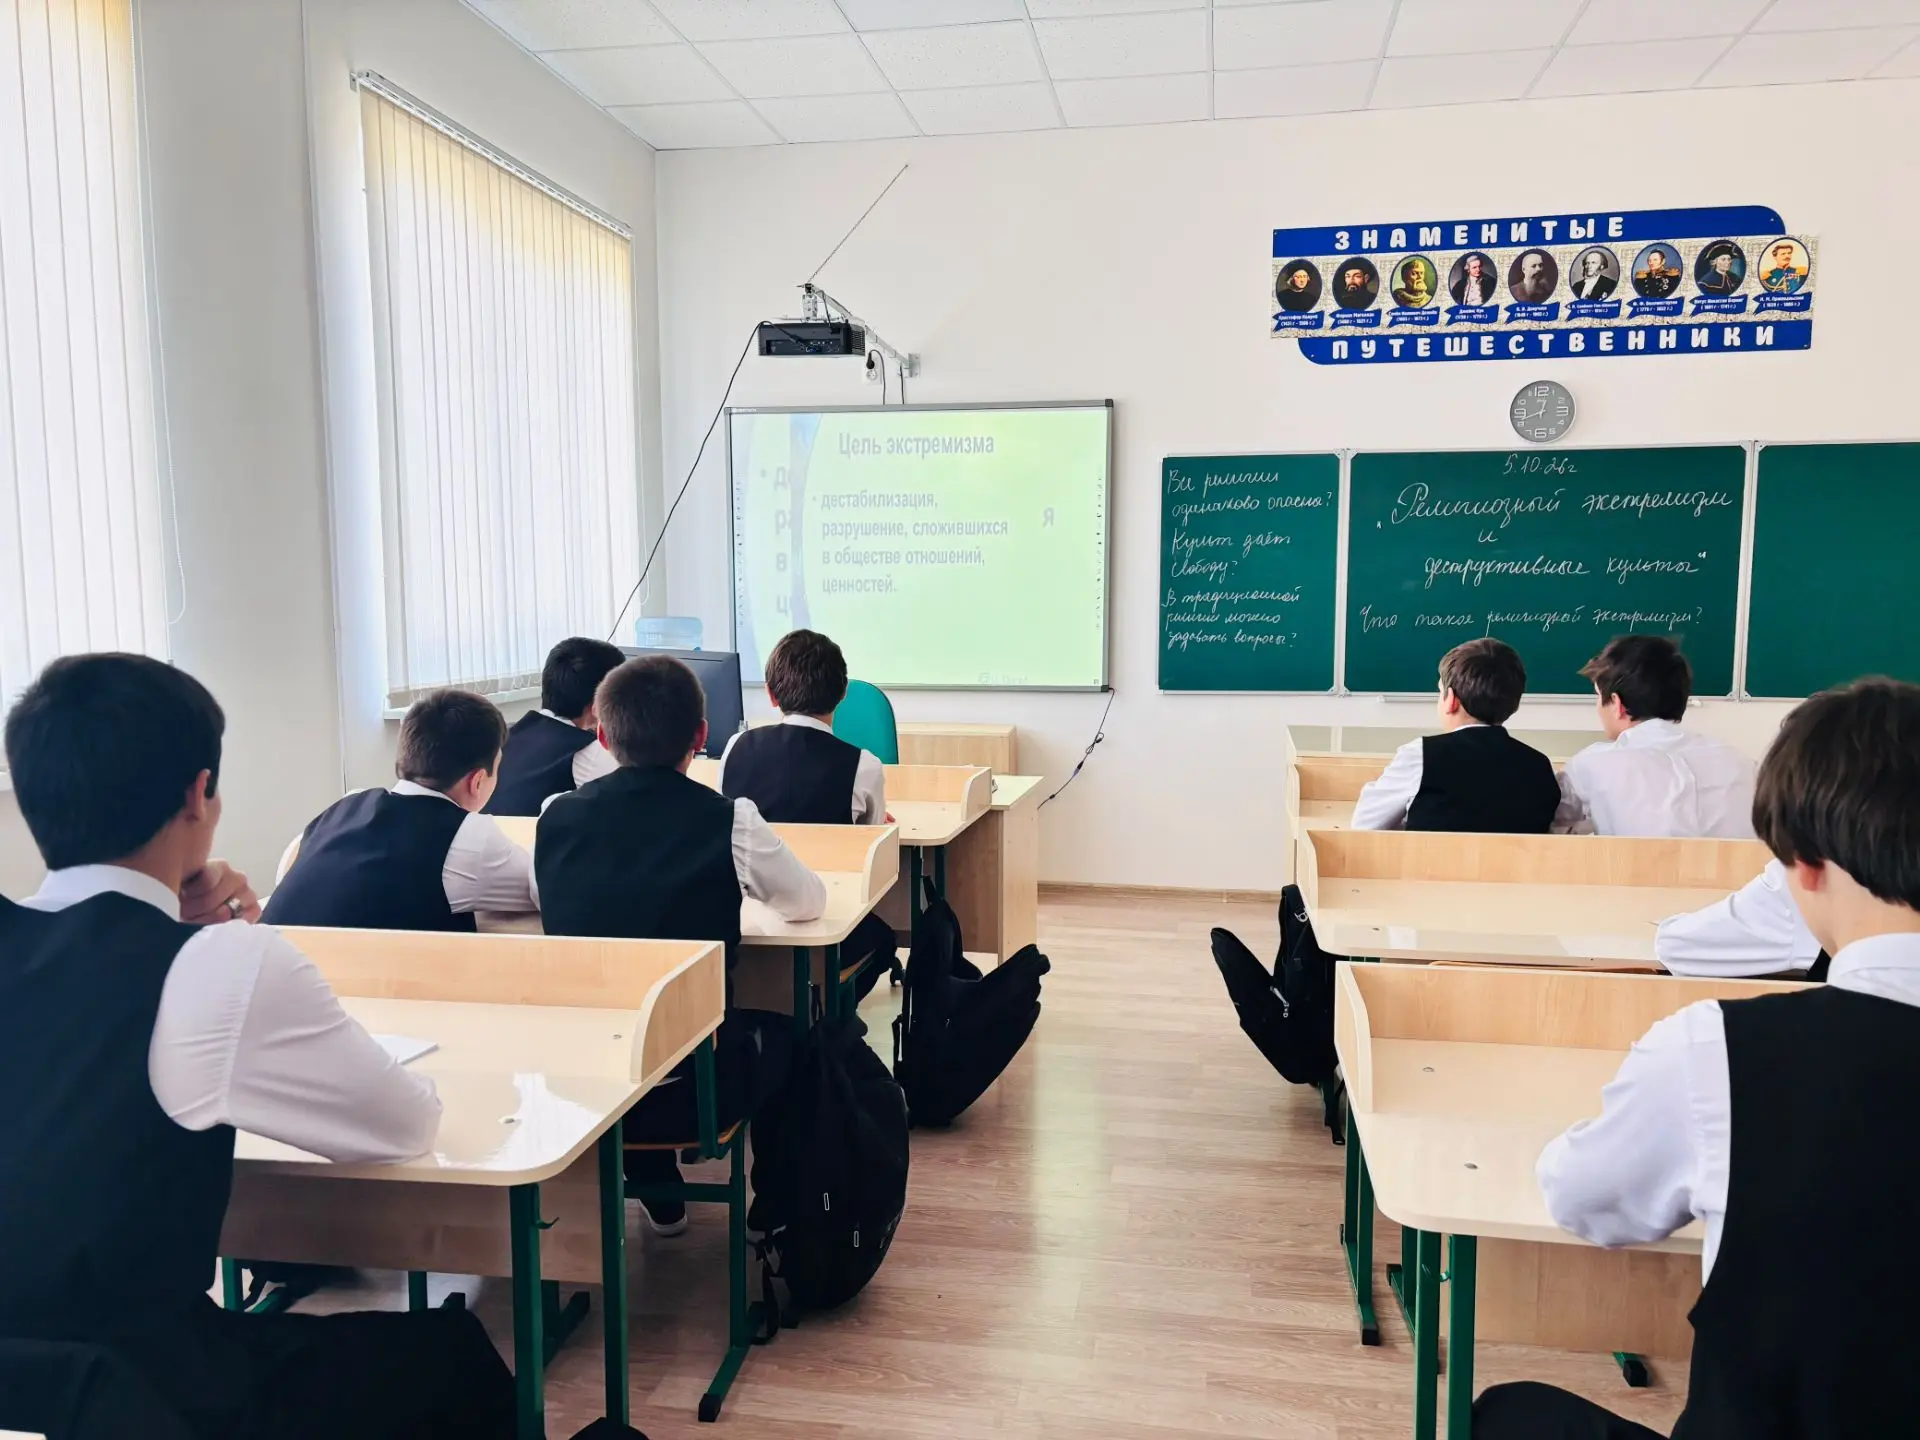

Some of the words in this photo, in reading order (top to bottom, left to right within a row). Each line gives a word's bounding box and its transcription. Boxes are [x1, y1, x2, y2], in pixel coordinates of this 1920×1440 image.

[1334, 216, 1624, 251] ЗНАМЕНИТЫЕ
[1332, 326, 1775, 360] ПУТЕШЕСТВЕННИКИ
[1534, 385, 1549, 397] 12
[1534, 427, 1547, 439] 6
[838, 432, 882, 459] Цель
[886, 436, 995, 459] экстремизма
[821, 489, 939, 511] дестабилизация,
[1581, 491, 1733, 519] экстремизм
[822, 520, 908, 541] разрушение,
[912, 520, 1009, 537] сложившихся
[1477, 529, 1499, 543] и
[1172, 528, 1234, 558] Культ
[834, 546, 900, 566] обществе
[905, 545, 985, 566] отношений,
[1424, 555, 1591, 589] деструктивные
[822, 574, 898, 594] ценностей.
[1161, 586, 1178, 608] В
